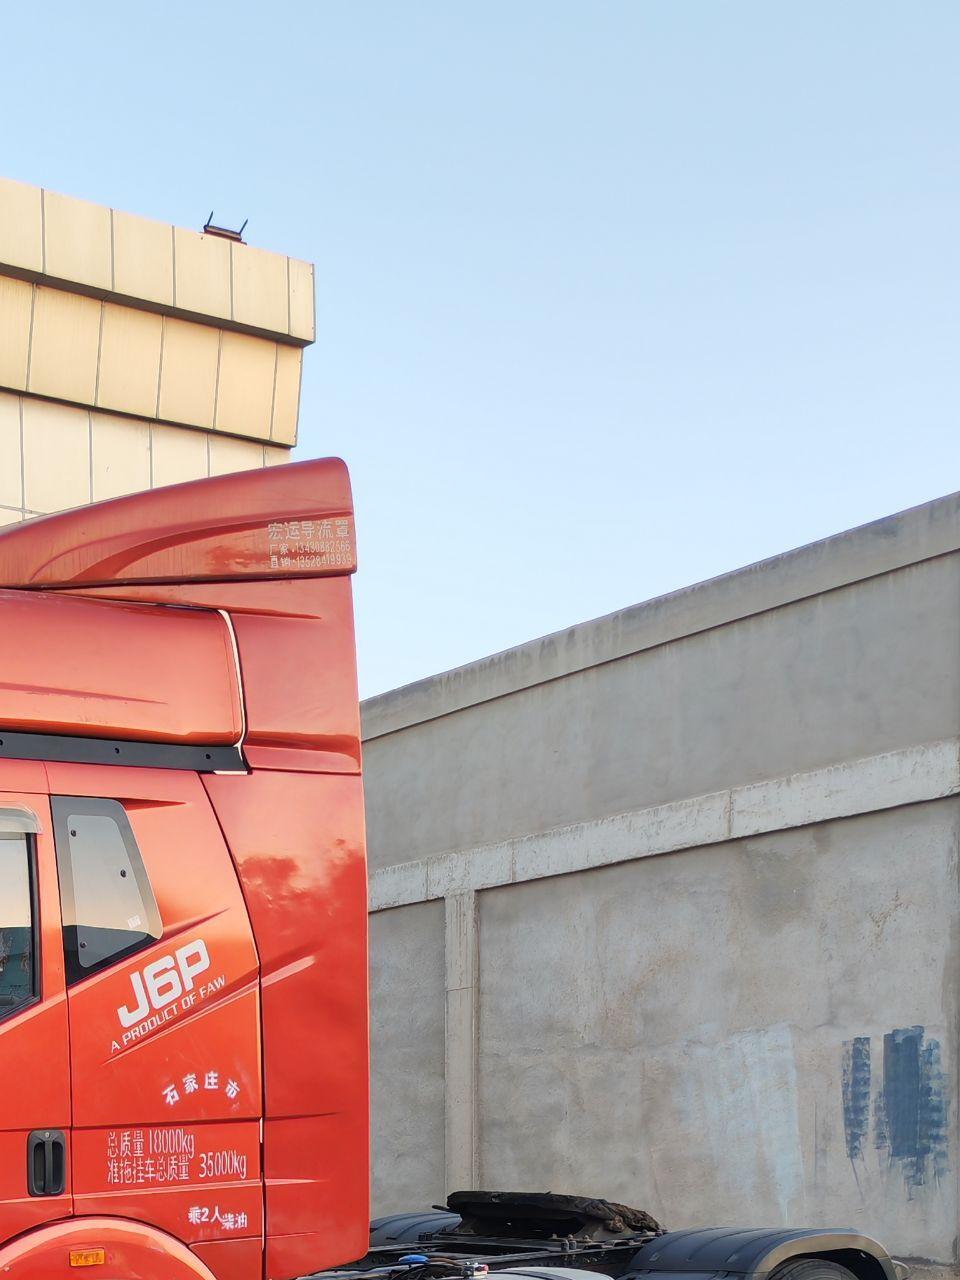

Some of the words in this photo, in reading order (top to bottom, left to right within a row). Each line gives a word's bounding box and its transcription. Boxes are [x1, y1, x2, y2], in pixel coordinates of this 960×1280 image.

[268, 520, 349, 540] 宏运导流罩
[117, 939, 210, 1028] J6P
[111, 1040, 121, 1053] A
[122, 1002, 178, 1045] PRODUCT
[181, 993, 197, 1010] OF
[199, 974, 226, 999] FAW
[162, 1070, 240, 1106] 石家庄市
[107, 1130, 144, 1158] 总质量
[148, 1128, 195, 1159] 18000kg
[198, 1150, 247, 1179] 35000kg
